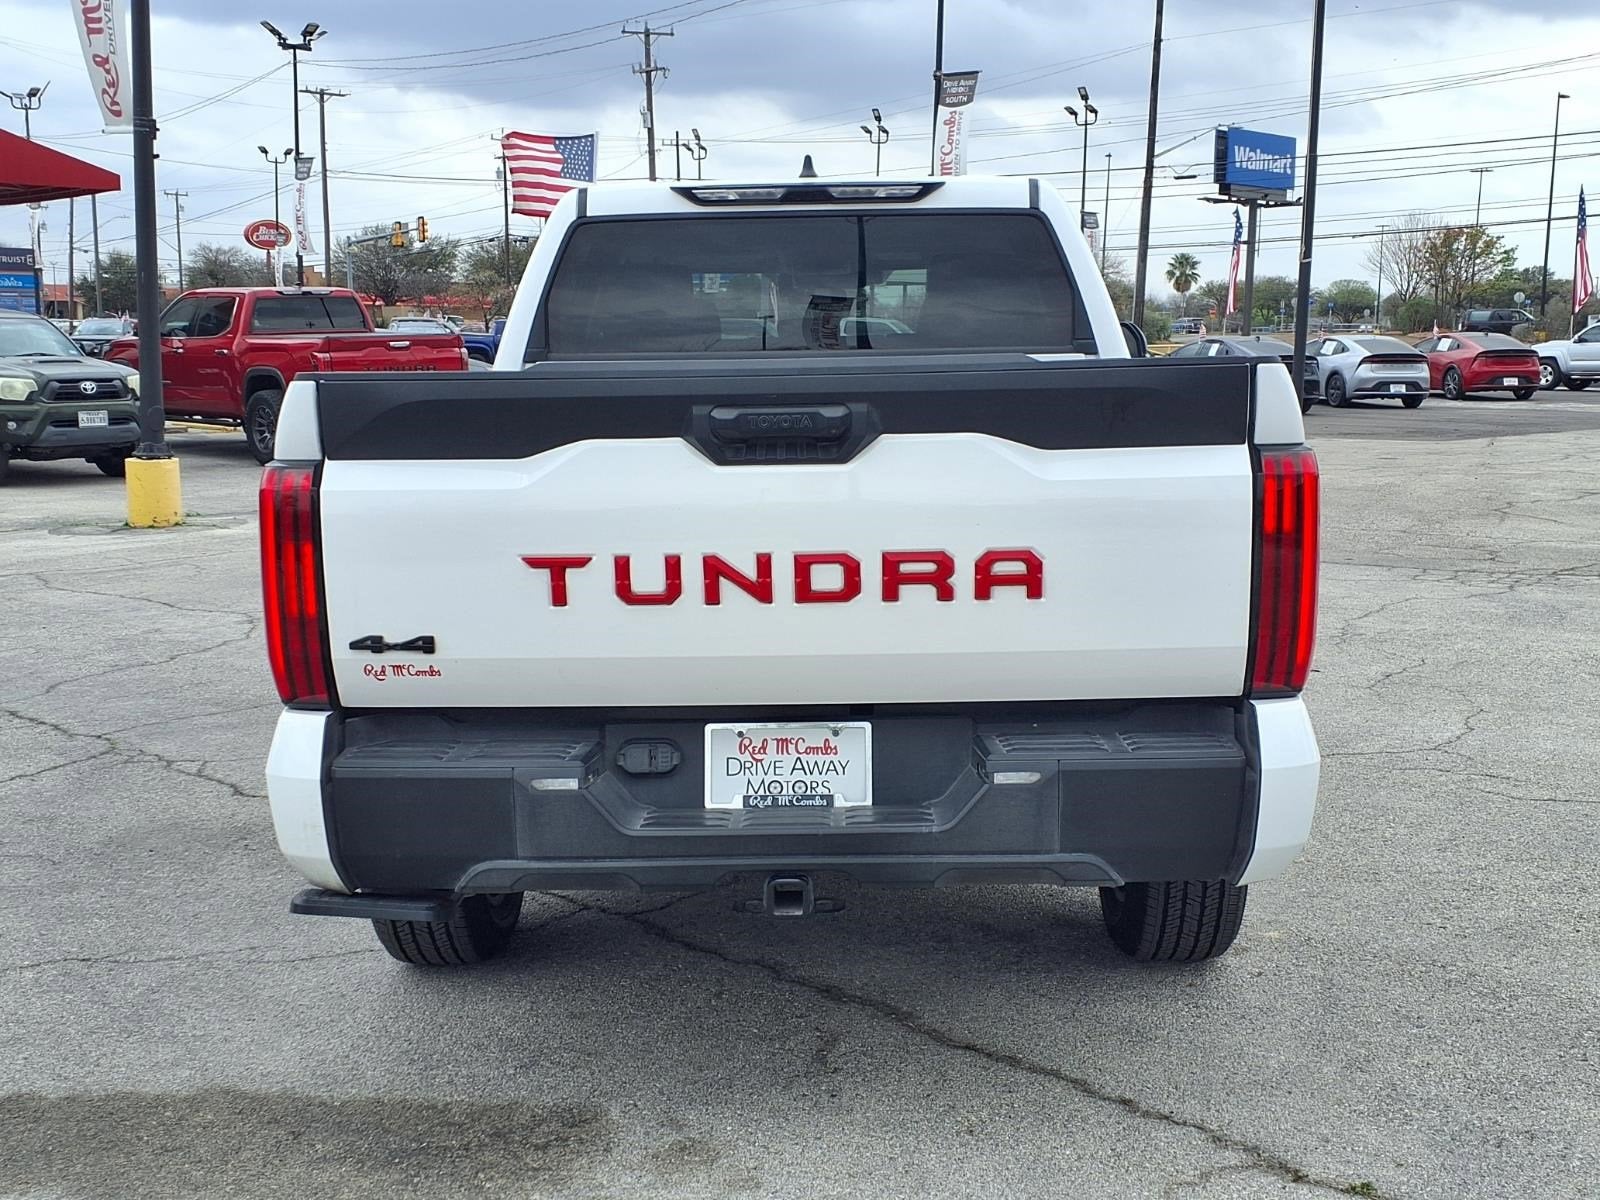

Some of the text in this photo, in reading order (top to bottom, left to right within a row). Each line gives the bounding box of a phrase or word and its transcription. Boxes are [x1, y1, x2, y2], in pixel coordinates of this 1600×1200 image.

[103, 0, 116, 55] DRIVE
[92, 53, 122, 118] Red
[943, 80, 959, 88] DRIVE
[945, 95, 968, 103] SOUTH
[940, 110, 957, 176] McCombs
[1234, 145, 1292, 174] Walmart
[749, 415, 813, 428] TOYOTA
[520, 549, 1043, 607] TUNDRA
[364, 663, 442, 681] Red McCombs
[738, 736, 838, 762] Red McCombs
[726, 757, 850, 776] DRIVE AWAY
[745, 778, 832, 794] MOTORS
[750, 796, 828, 808] Red McCombs
